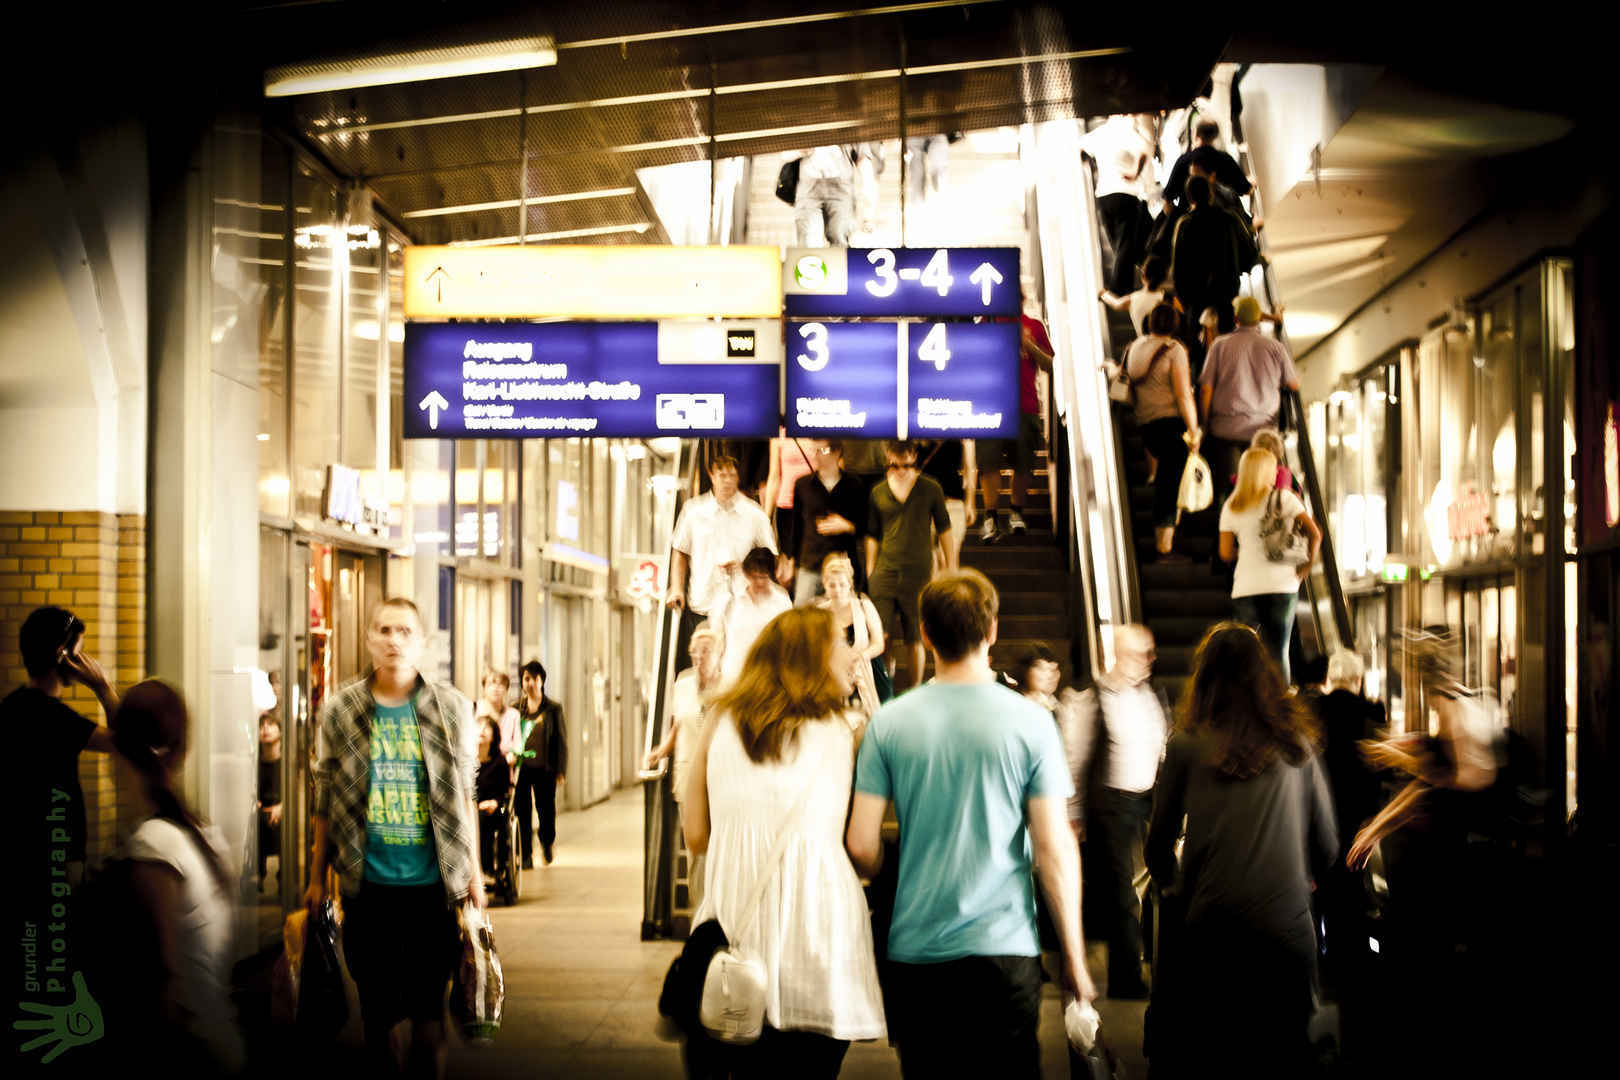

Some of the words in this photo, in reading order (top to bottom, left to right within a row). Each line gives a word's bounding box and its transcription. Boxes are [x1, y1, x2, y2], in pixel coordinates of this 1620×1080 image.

[864, 248, 954, 298] 3-4
[797, 322, 830, 371] 3
[918, 323, 951, 371] 4
